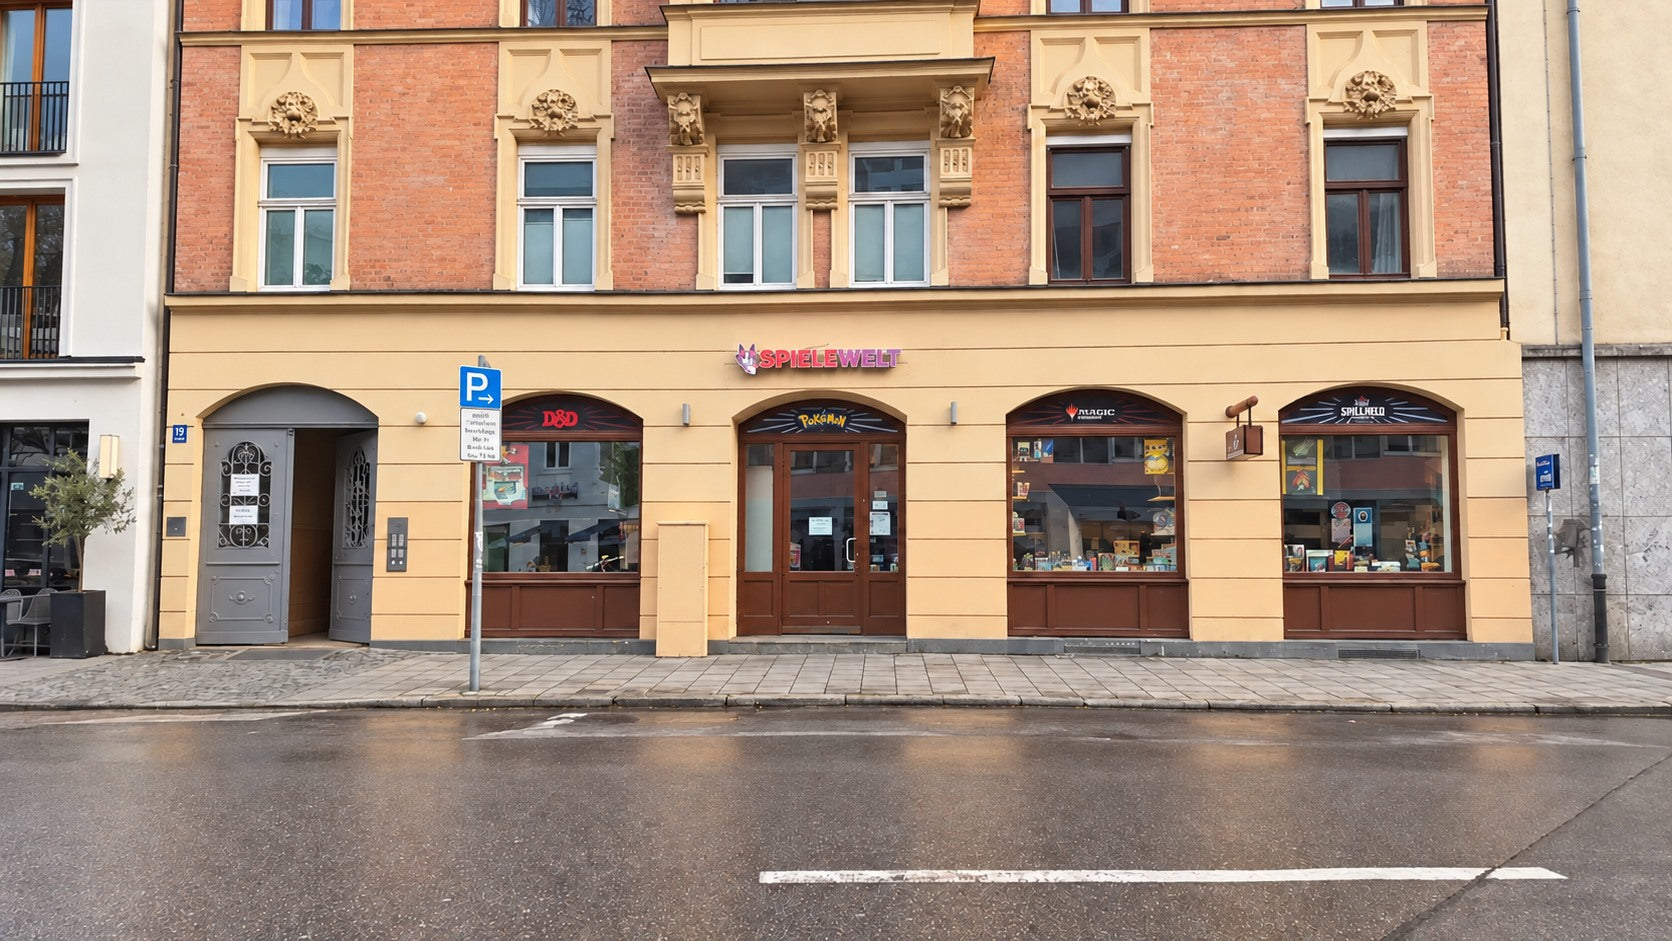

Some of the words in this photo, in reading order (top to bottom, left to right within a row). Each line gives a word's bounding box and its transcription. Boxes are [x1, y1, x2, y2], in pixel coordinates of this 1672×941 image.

[759, 349, 901, 368] SPIELEWELT
[466, 371, 489, 402] P
[542, 409, 579, 428] D&D
[1078, 408, 1115, 416] MAGIC
[175, 427, 185, 437] 19
